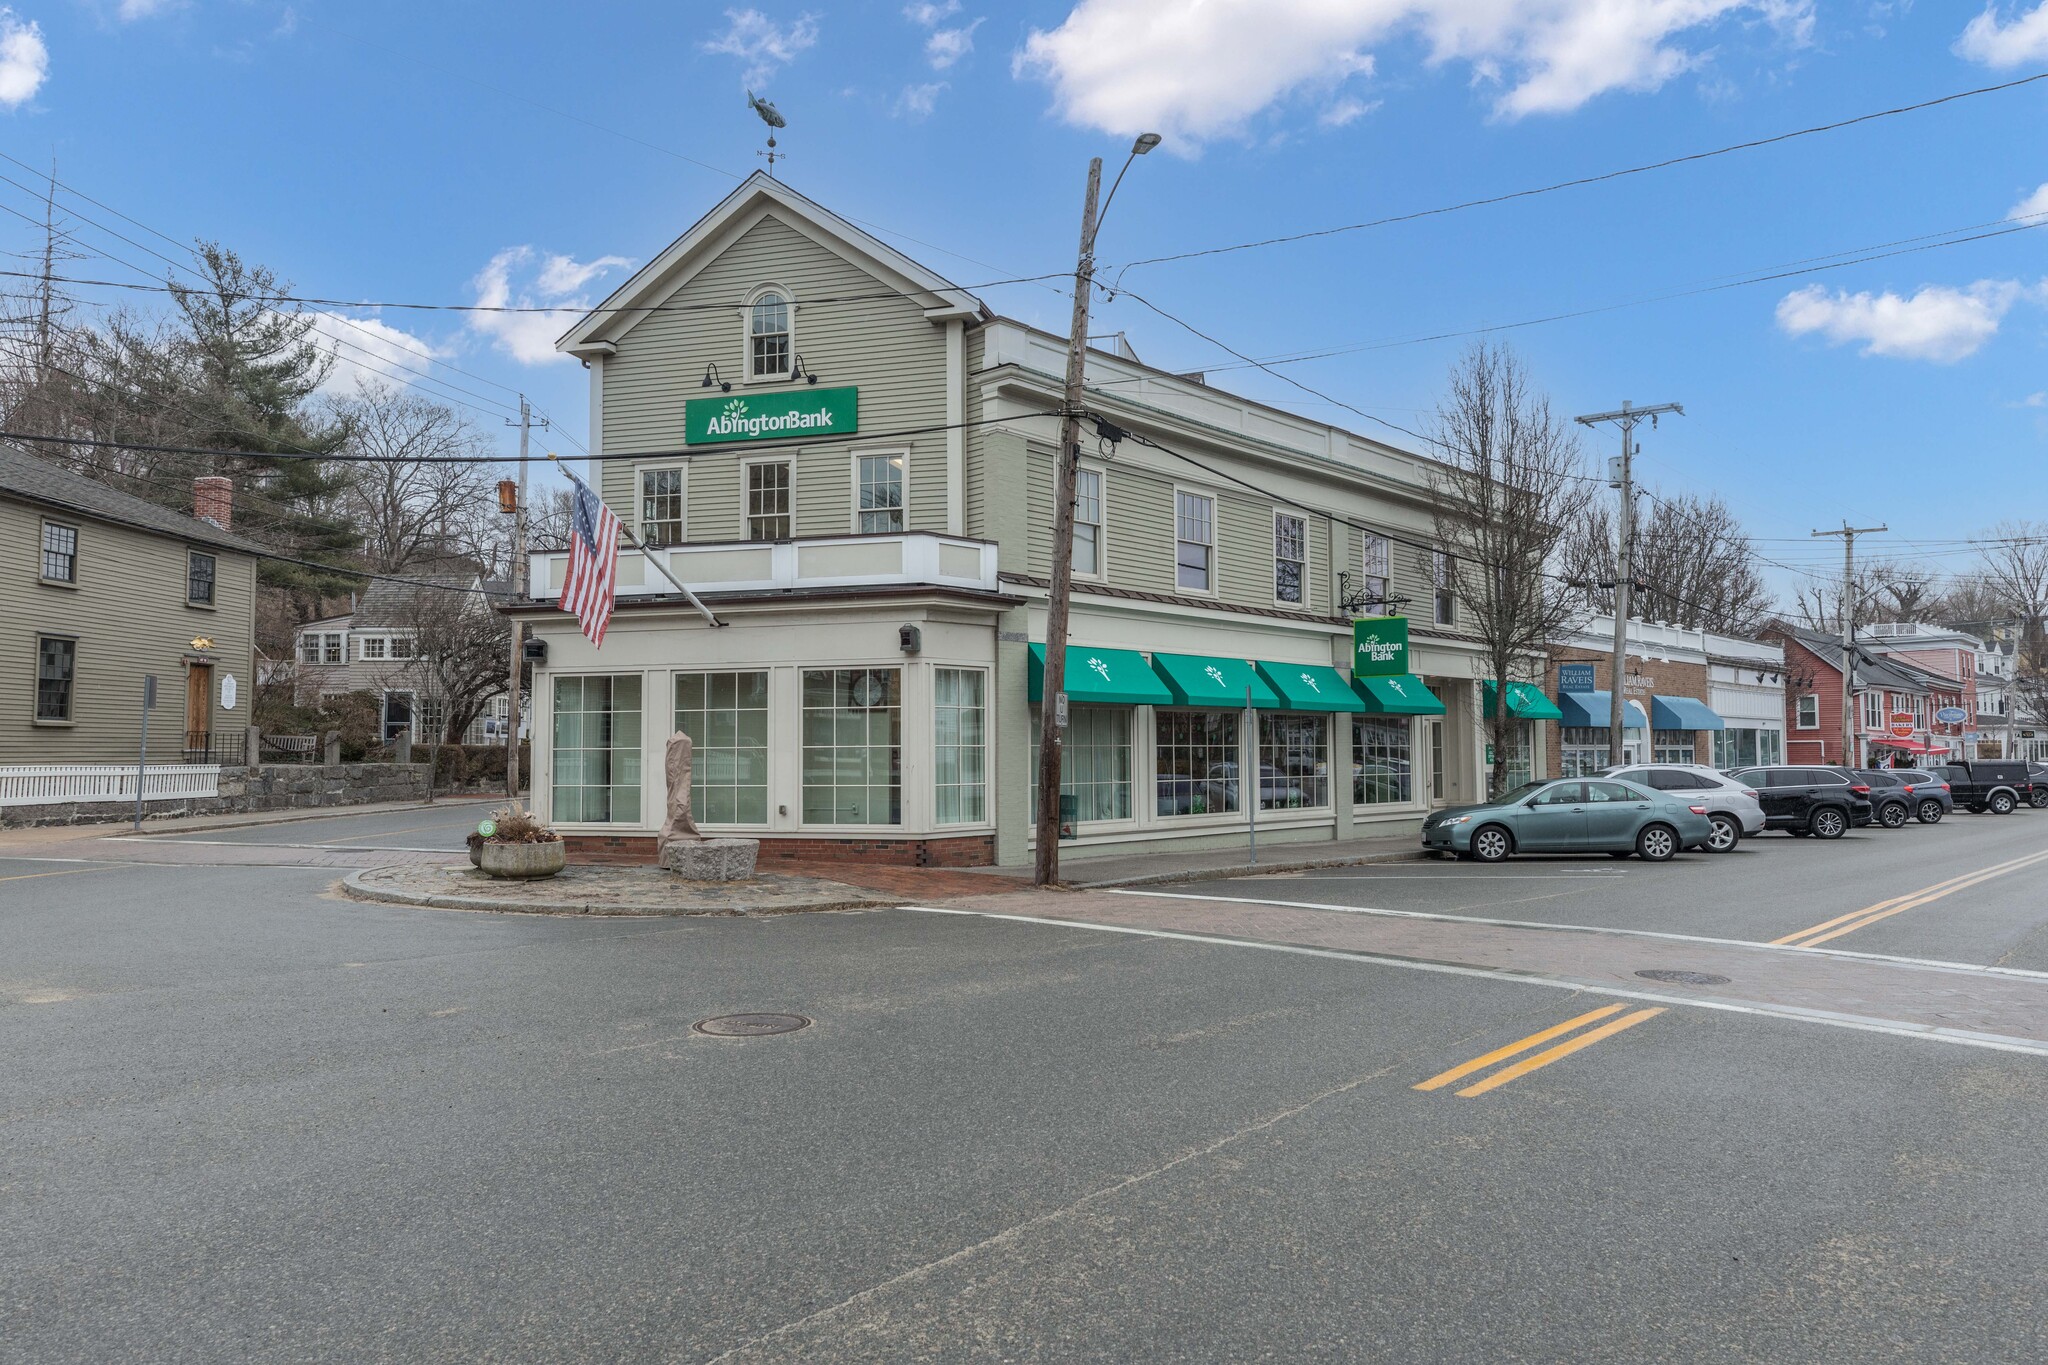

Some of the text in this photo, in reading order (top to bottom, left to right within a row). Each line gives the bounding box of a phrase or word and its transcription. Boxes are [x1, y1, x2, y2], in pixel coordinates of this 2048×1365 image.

[1358, 641, 1402, 654] Abington
[1371, 651, 1395, 661] Bank
[1561, 675, 1593, 684] RAVEIS
[1637, 675, 1654, 688] RAVEIS
[1059, 694, 1066, 704] NO
[1059, 705, 1064, 714] U
[1056, 714, 1067, 724] TURN
